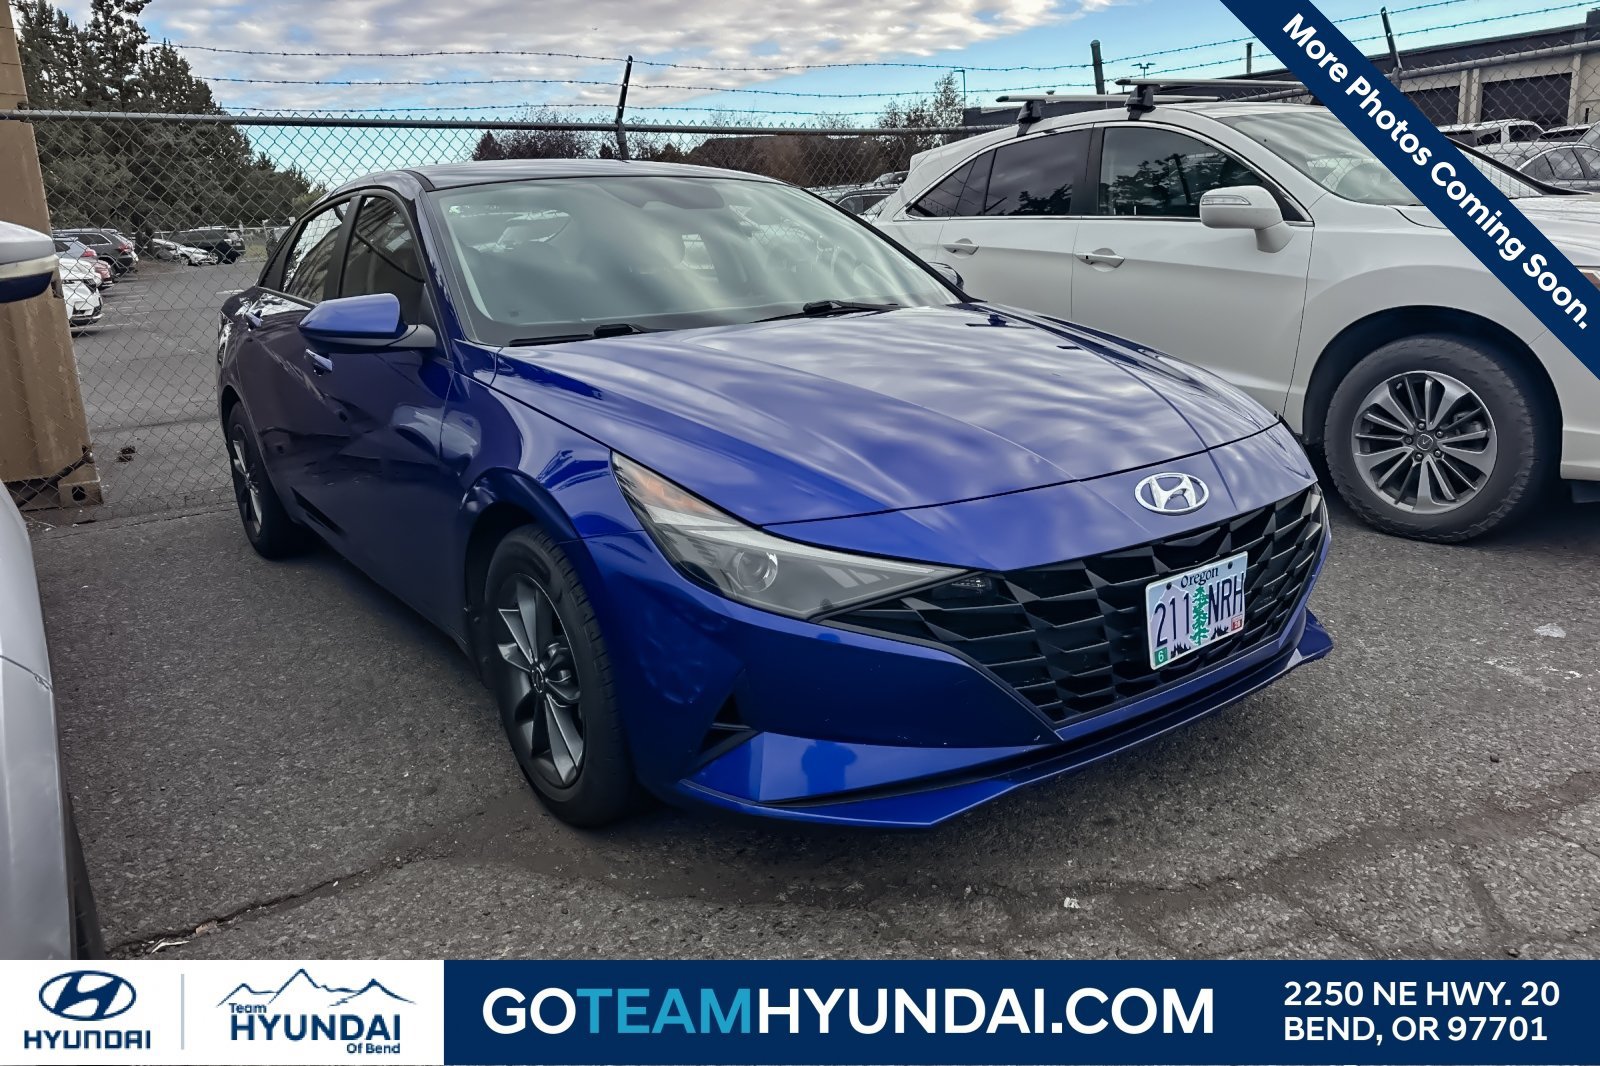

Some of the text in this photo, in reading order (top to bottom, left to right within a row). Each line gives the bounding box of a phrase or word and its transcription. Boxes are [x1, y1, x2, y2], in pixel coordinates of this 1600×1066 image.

[1181, 567, 1219, 588] Oregon
[1155, 573, 1244, 647] 211 NRH
[1158, 651, 1164, 662] 6
